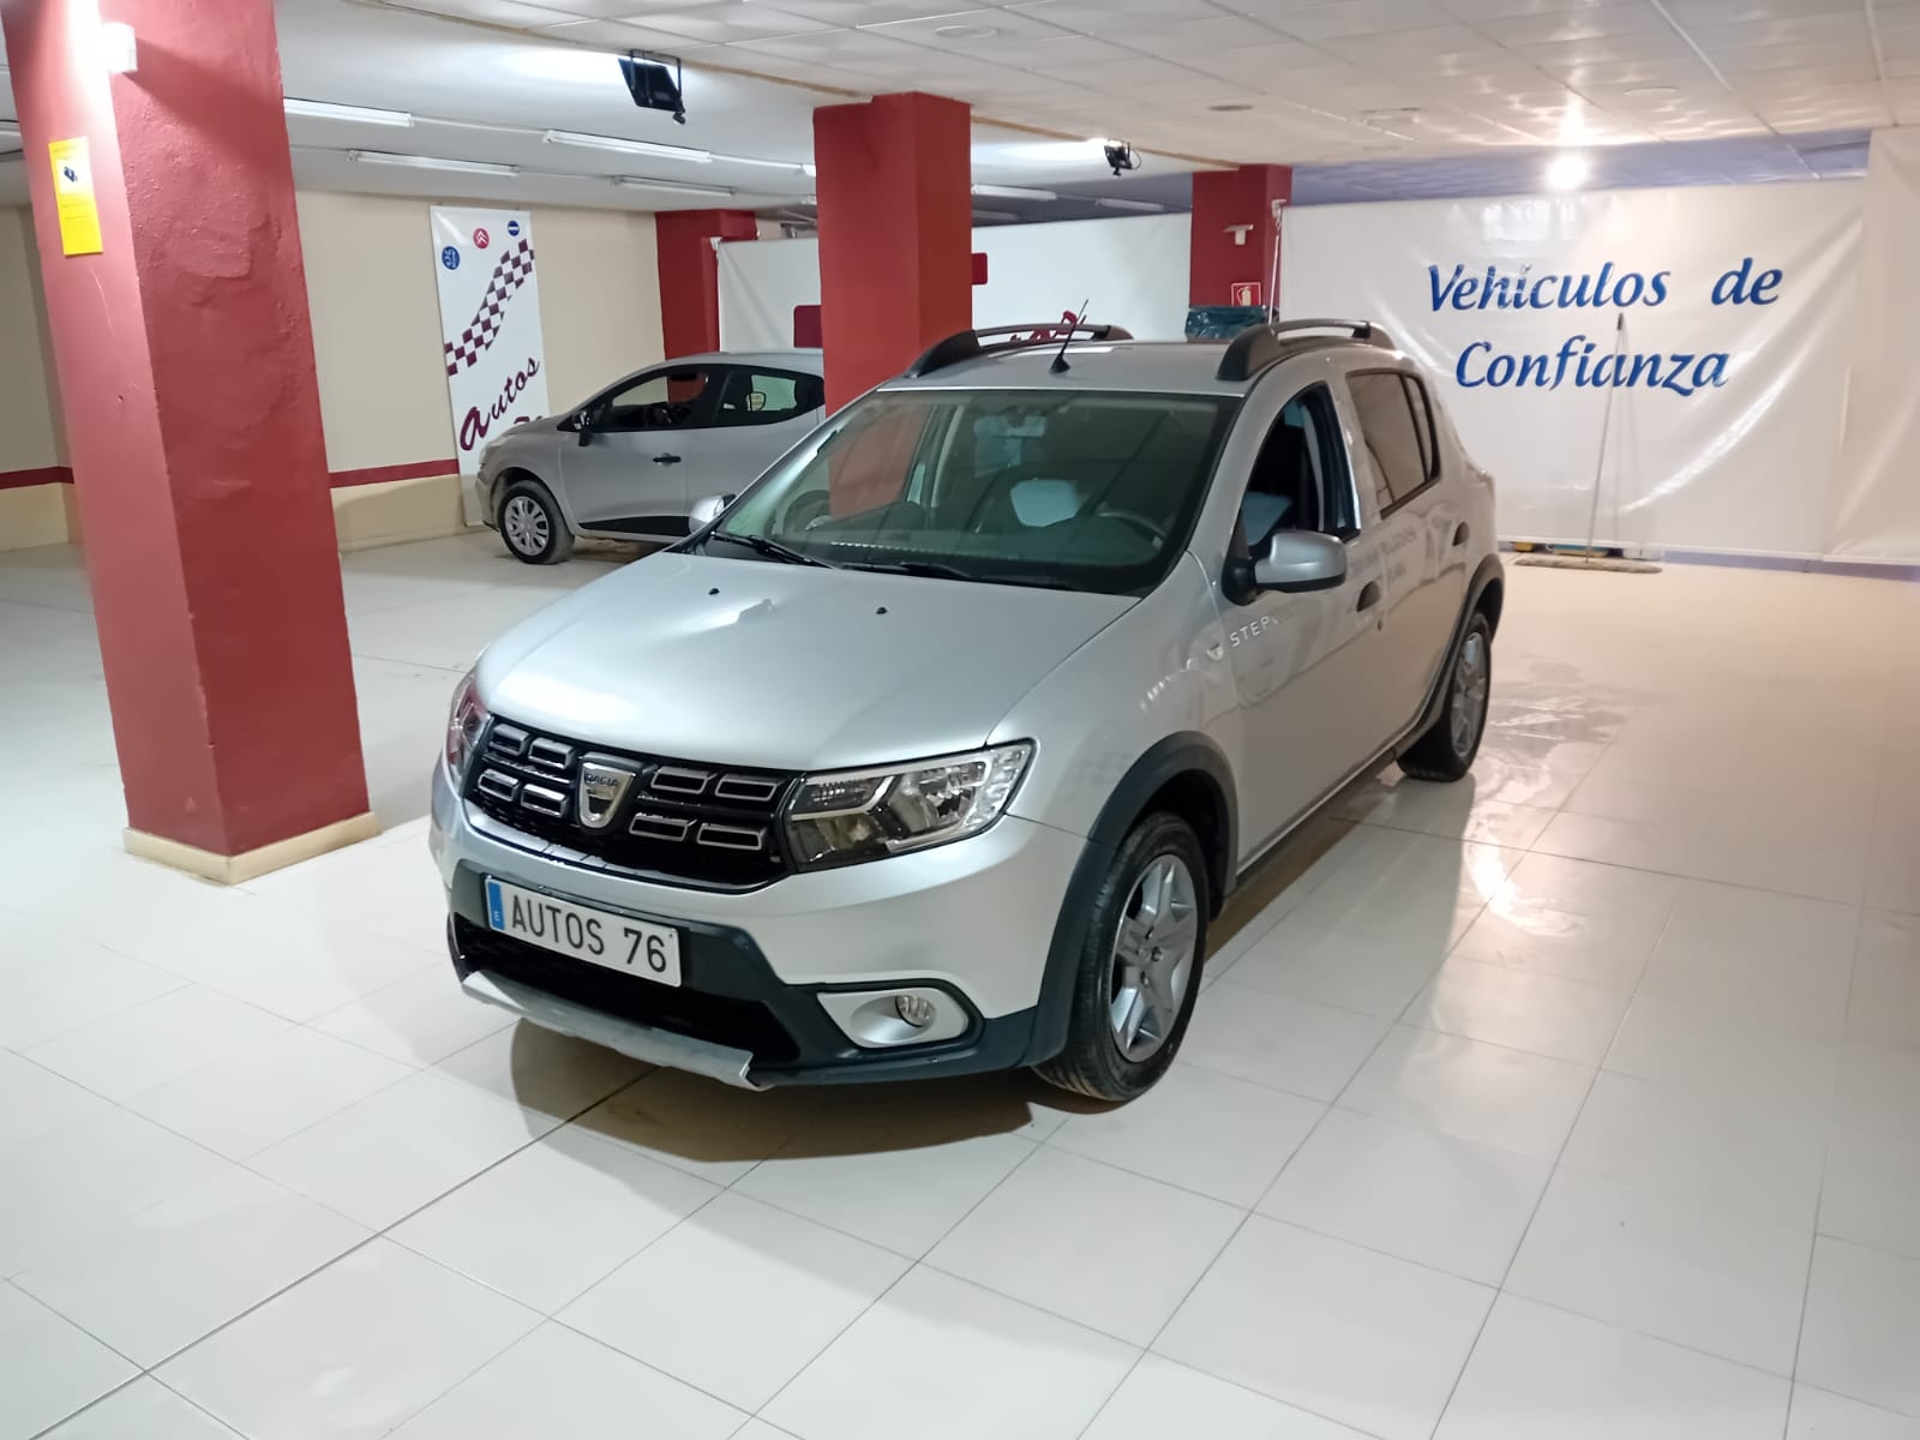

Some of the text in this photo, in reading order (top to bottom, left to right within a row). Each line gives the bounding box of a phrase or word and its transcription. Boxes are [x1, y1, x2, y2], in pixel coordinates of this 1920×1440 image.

[1711, 257, 1783, 306] de
[1456, 334, 1730, 397] Confianza
[512, 895, 667, 973] AUTOS 76
